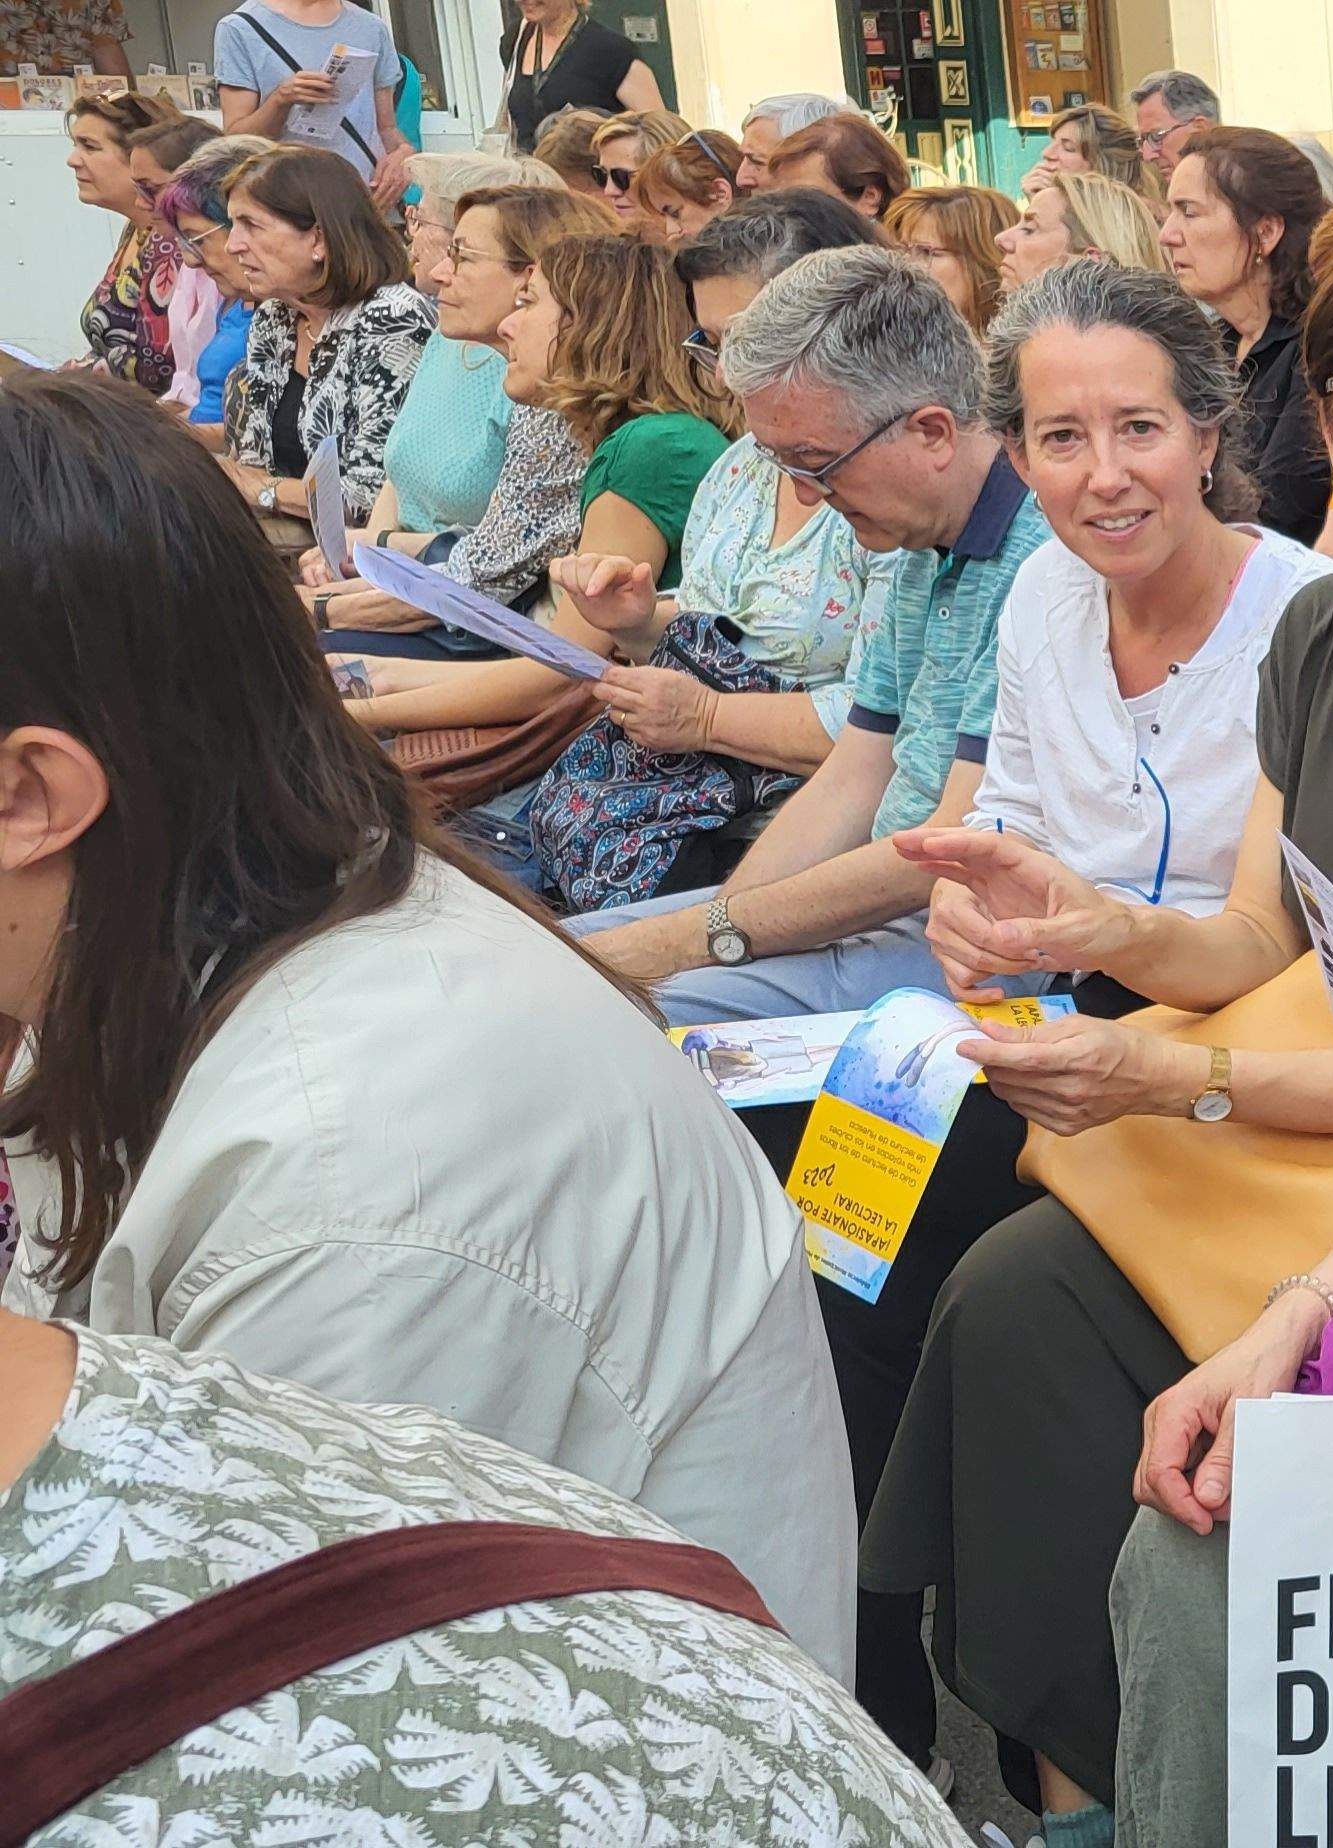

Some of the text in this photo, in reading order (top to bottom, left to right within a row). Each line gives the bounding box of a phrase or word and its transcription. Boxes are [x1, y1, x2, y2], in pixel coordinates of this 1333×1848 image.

[839, 1143, 850, 1153] los
[849, 1120, 927, 1164] de lectura de Huesca
[855, 1138, 864, 1148] los
[866, 1143, 876, 1152] en
[851, 1149, 861, 1159] de
[877, 1148, 905, 1165] votados
[862, 1155, 887, 1173] lectura
[887, 1167, 899, 1177] de
[803, 1162, 836, 1187] 2023
[833, 1192, 898, 1235] LA LECTURA!
[797, 1195, 891, 1251] ¡APASIÓNATE POR
